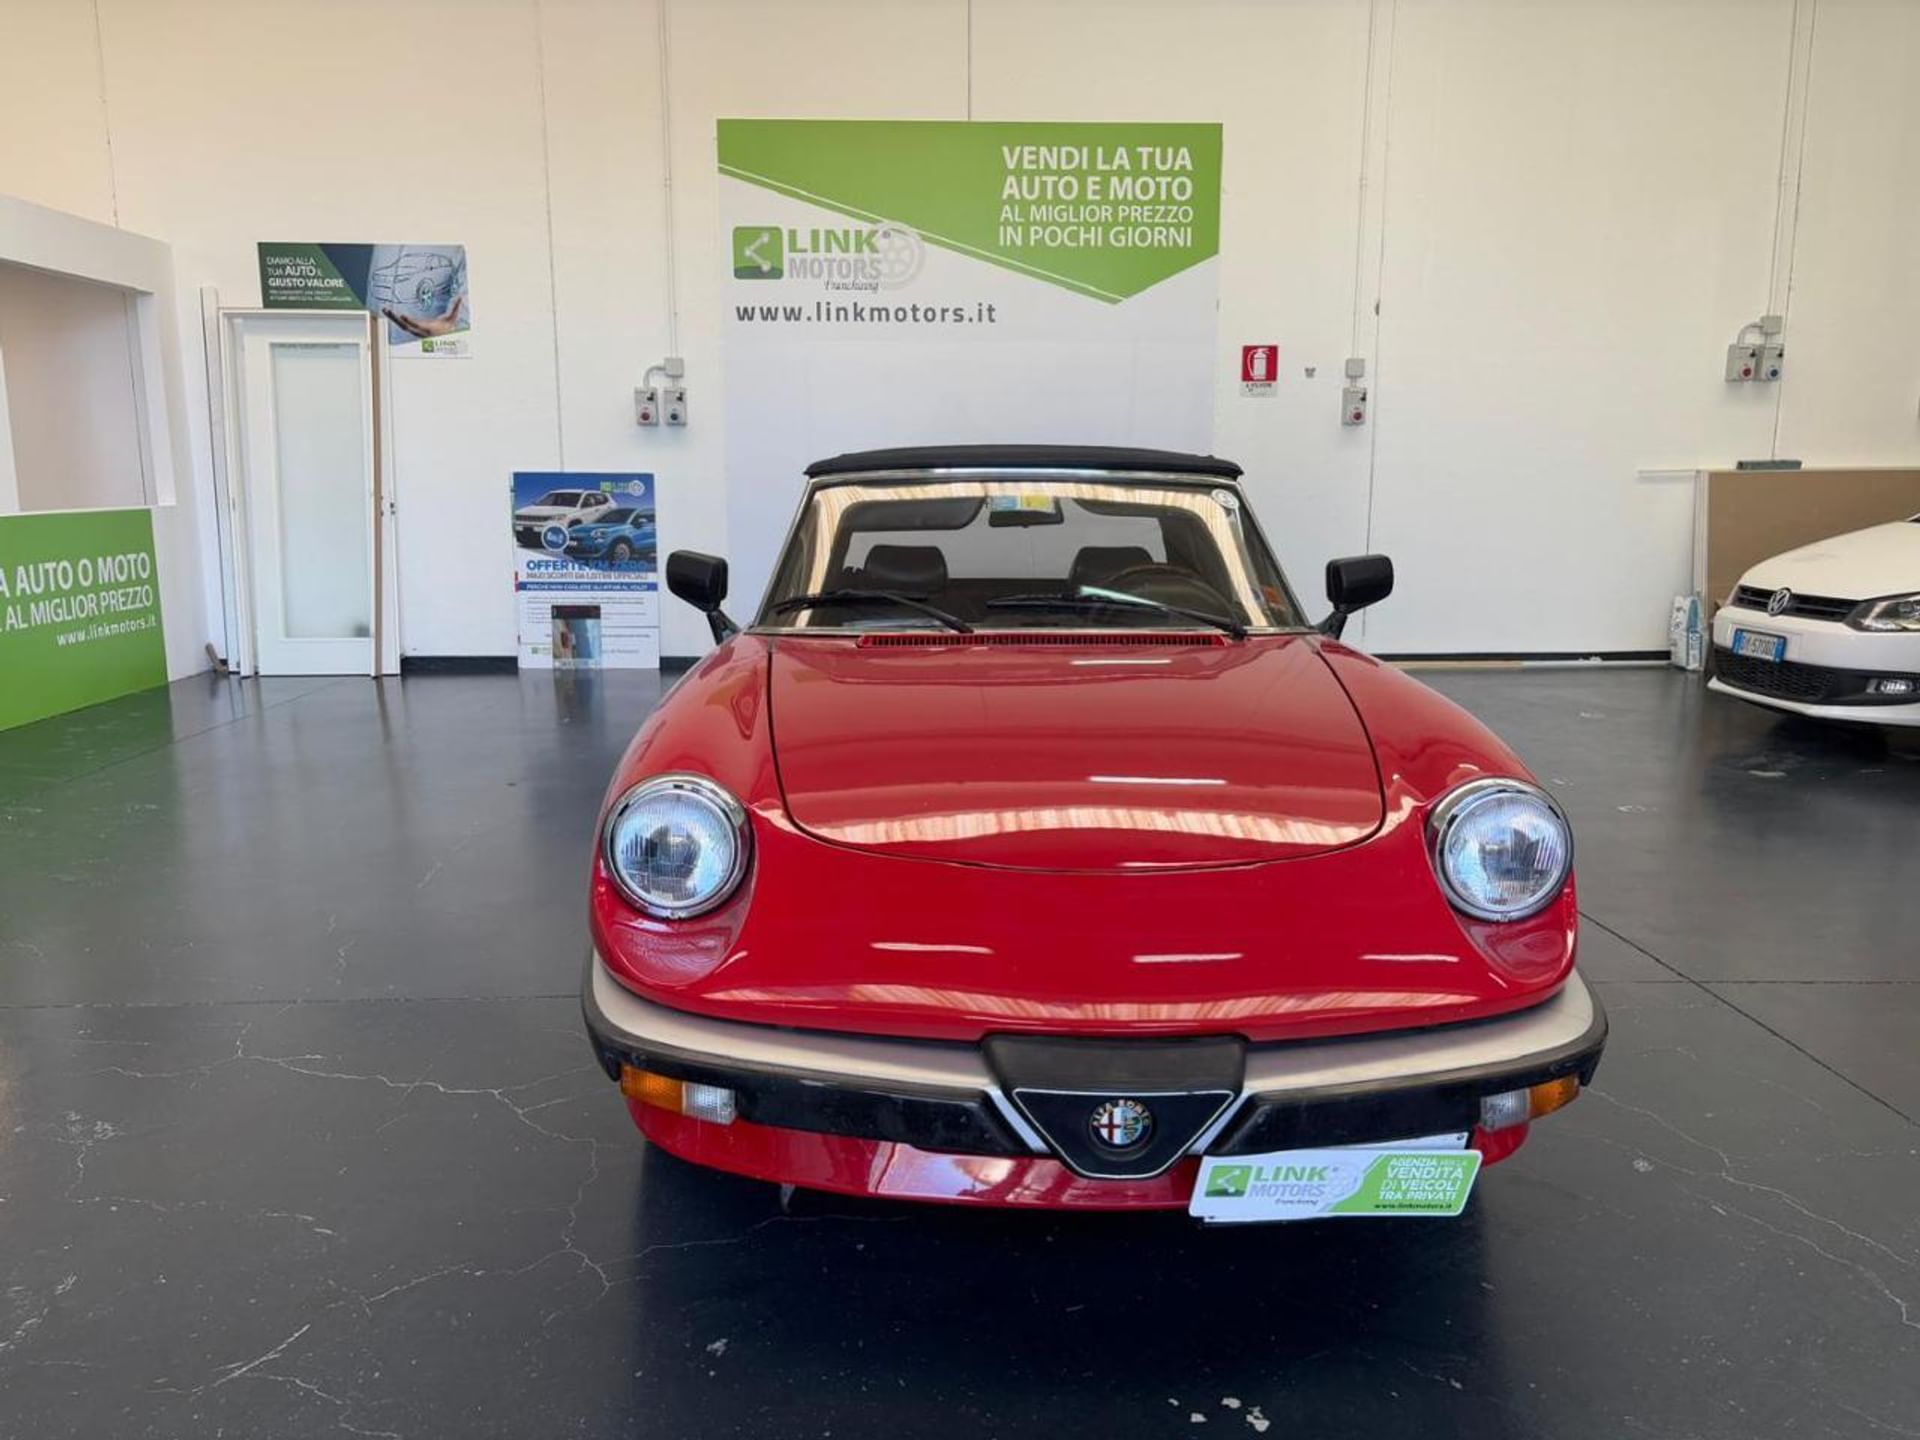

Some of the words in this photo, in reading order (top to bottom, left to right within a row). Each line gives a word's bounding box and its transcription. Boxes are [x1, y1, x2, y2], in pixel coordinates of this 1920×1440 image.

[1002, 146, 1088, 170] VENDI
[1096, 147, 1131, 171] LA
[1136, 147, 1193, 171] TUA
[1002, 176, 1079, 200] AUTO
[1087, 177, 1101, 200] E
[1109, 176, 1193, 200] MOTO
[1000, 205, 1025, 222] AL
[1030, 205, 1113, 222] MIGLIOR
[1118, 205, 1194, 223] PREZZO
[788, 229, 880, 253] LINK
[1000, 226, 1022, 246] IN
[1030, 226, 1102, 246] POCHI
[1109, 226, 1192, 247] GIORNI
[285, 266, 316, 276] AUTO
[788, 257, 882, 280] MOTORS
[268, 278, 305, 287] GIUSTO
[306, 278, 345, 288] VALORE
[736, 301, 997, 324] www.linkmotors.it
[16, 560, 73, 597] AUTO
[78, 558, 93, 587] O
[97, 552, 150, 584] MOTO
[526, 559, 586, 571] OFFERTE
[6, 604, 28, 631] AL
[30, 593, 98, 627] MIGLIOR
[100, 584, 153, 615] PREZZO
[57, 614, 156, 646] www.linkmotors.it
[1253, 1166, 1328, 1181] LINK
[1388, 1166, 1463, 1179] VENDITA
[1249, 1184, 1325, 1198] MOTORS
[1401, 1180, 1461, 1191] VEICOLI
